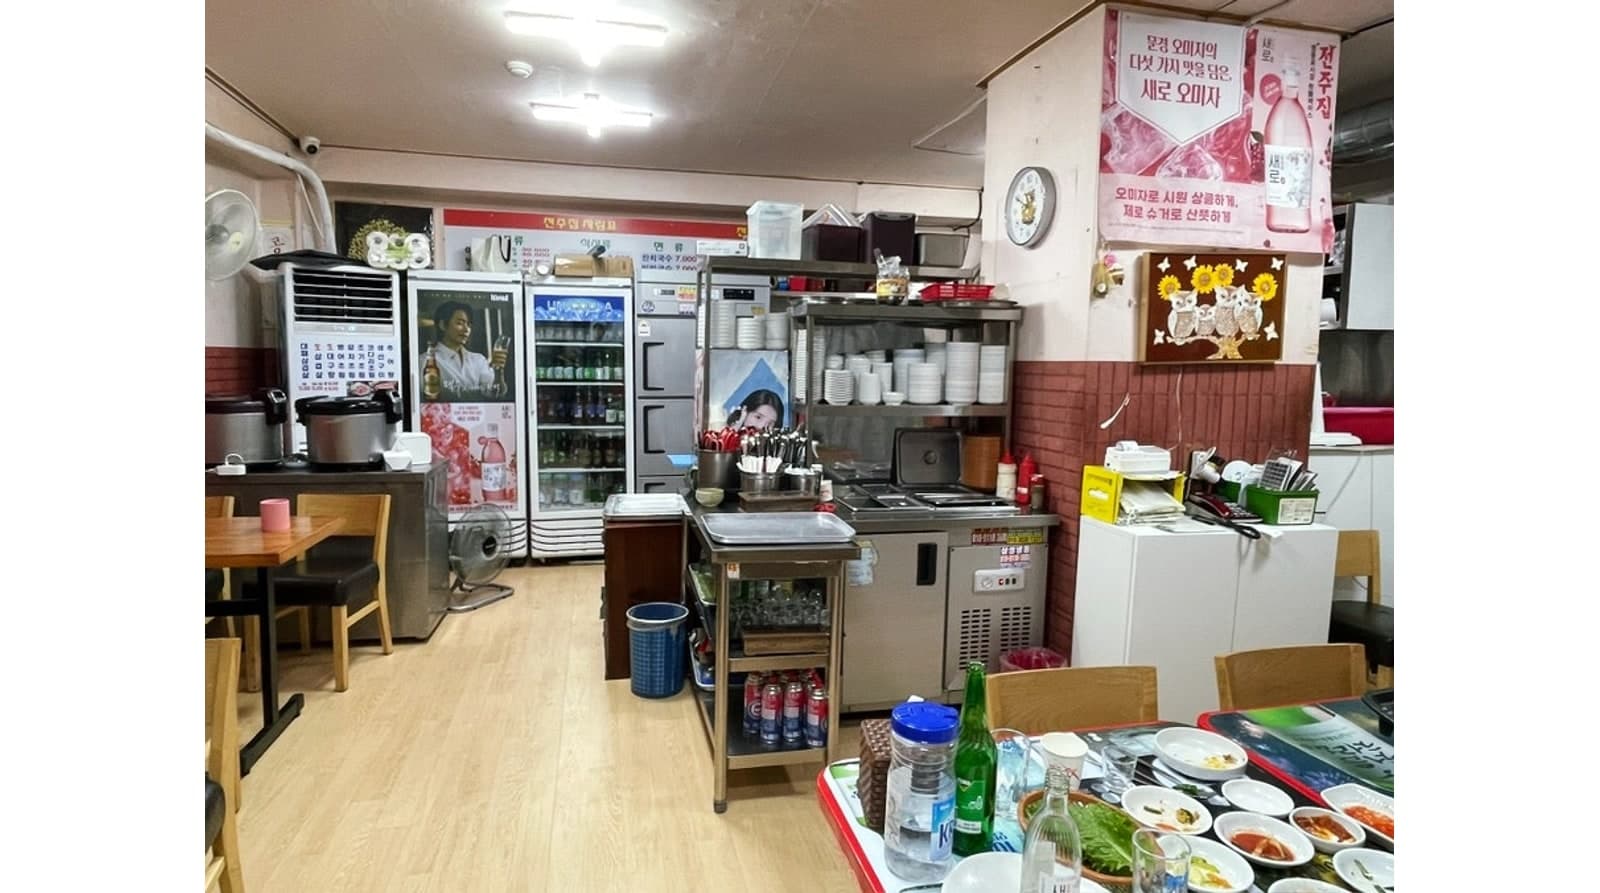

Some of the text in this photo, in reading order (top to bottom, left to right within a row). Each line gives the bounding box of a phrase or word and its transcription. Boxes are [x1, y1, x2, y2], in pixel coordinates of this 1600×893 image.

[1147, 34, 1168, 53] 문경
[1129, 53, 1153, 72] 다섯
[1157, 56, 1180, 75] 가지
[1183, 60, 1204, 78] 맛을
[1140, 78, 1222, 108] 새로 오미자
[1316, 45, 1336, 119] 전주집
[1115, 187, 1159, 203] 오미자로
[1163, 190, 1188, 204] 시원
[1123, 204, 1231, 223] 제로 슈거로 산뜻하게
